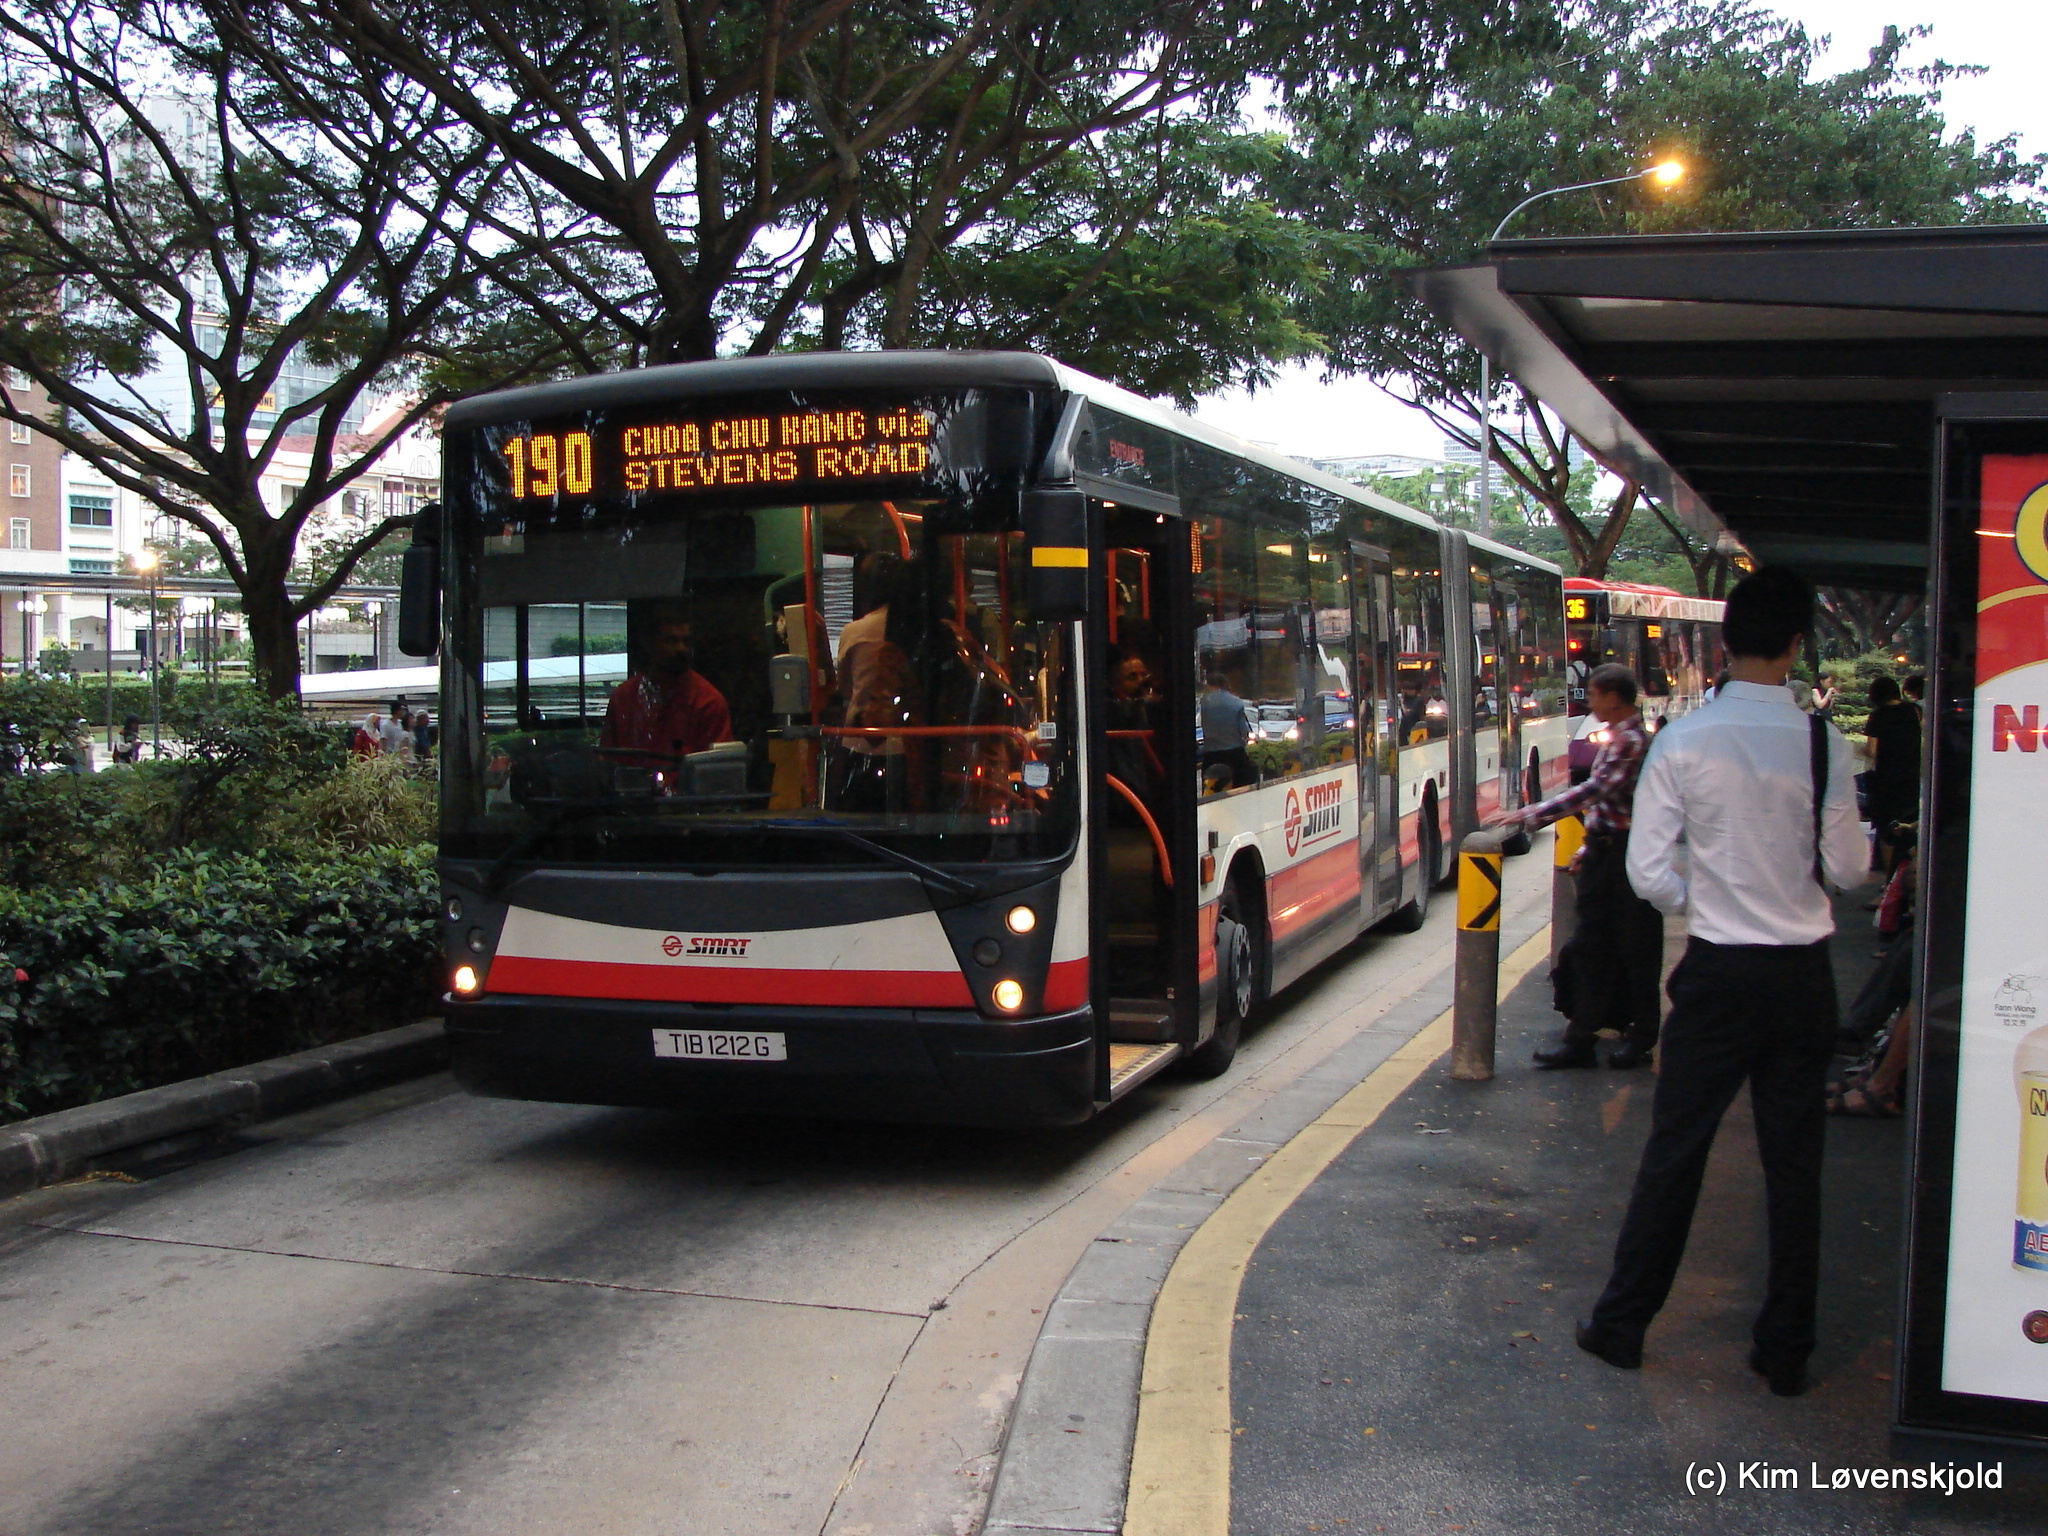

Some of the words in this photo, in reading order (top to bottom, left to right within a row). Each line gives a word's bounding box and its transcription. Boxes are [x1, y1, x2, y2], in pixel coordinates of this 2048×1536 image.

[624, 423, 700, 457] CHOA
[711, 417, 770, 451] CHU
[781, 410, 866, 446] KANG
[878, 407, 929, 439] via
[503, 431, 592, 498] 190
[624, 450, 798, 491] STEVENS
[816, 441, 926, 478] ROAD
[1303, 779, 1342, 838] SMRT
[686, 937, 752, 956] SMRT
